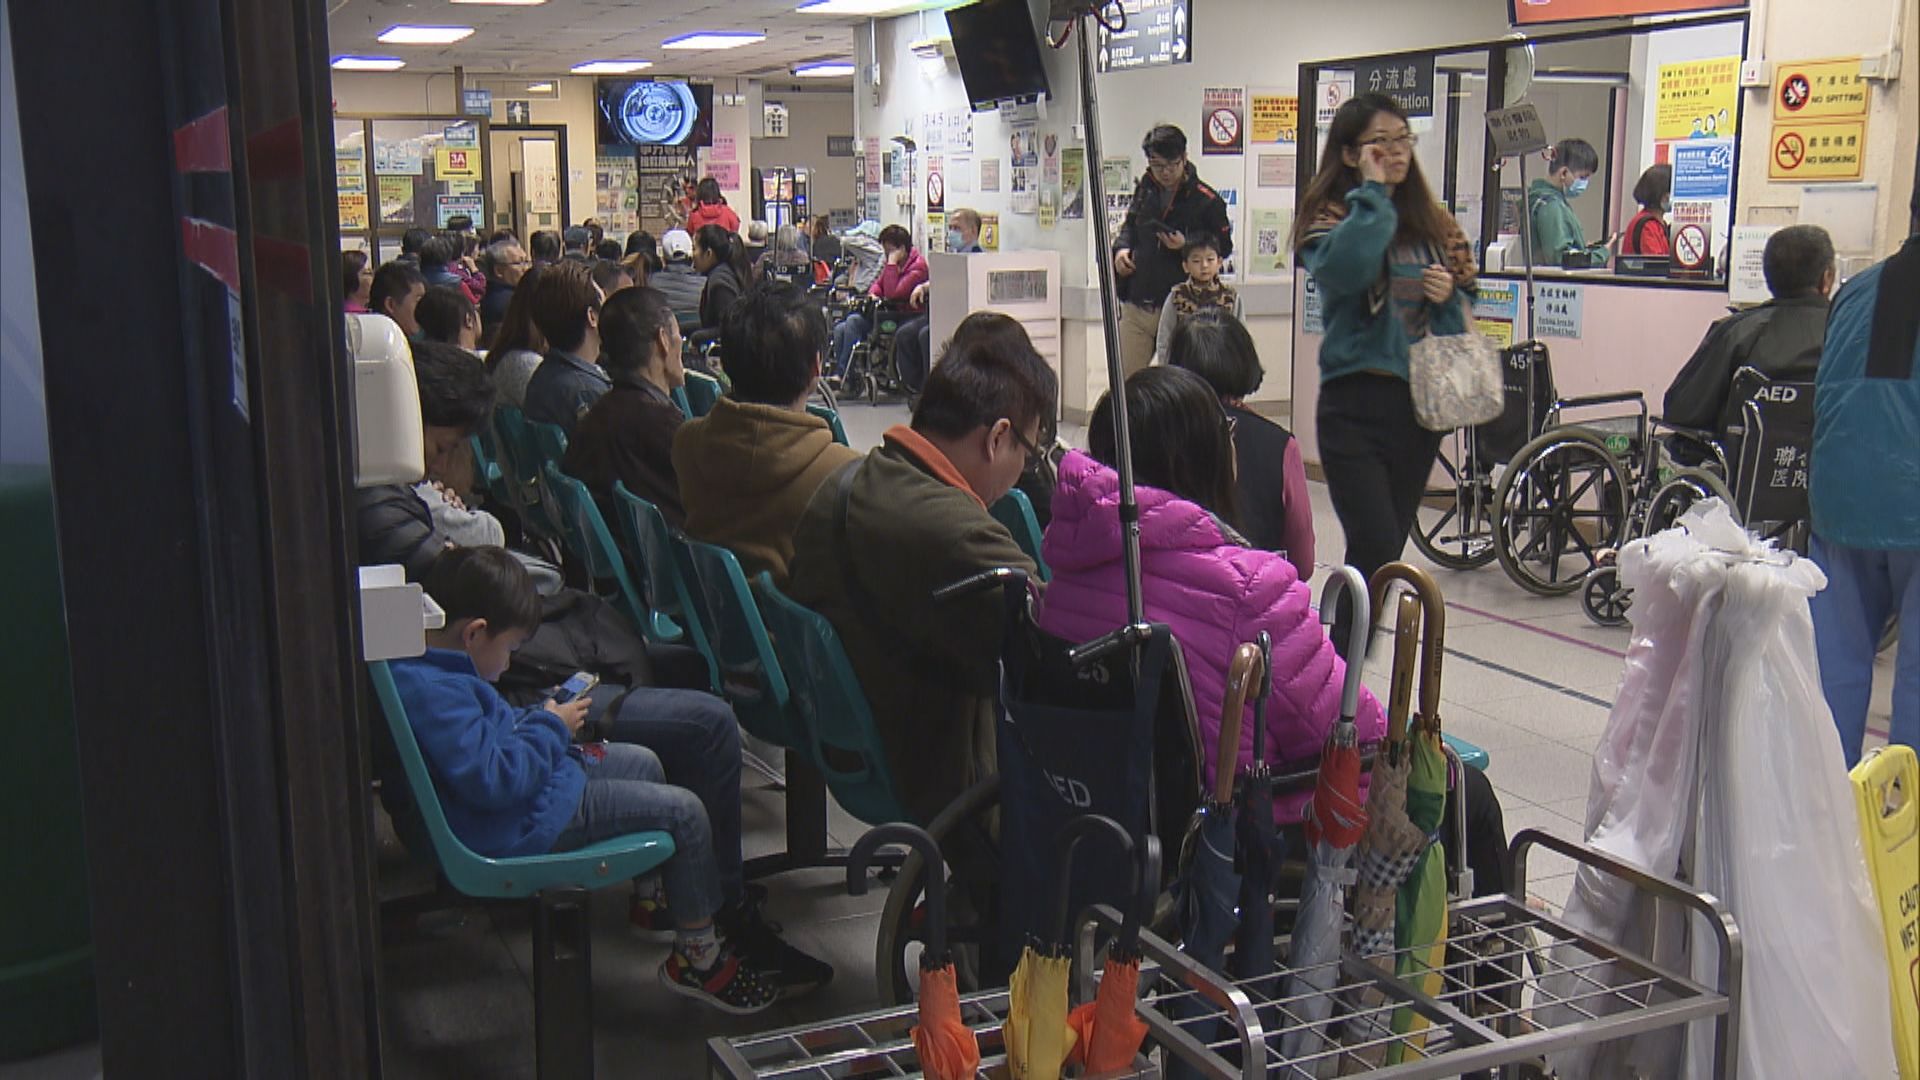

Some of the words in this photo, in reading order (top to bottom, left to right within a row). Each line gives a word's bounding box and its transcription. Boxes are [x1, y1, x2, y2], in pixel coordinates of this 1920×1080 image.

[1369, 65, 1417, 92] 分流處
[1811, 95, 1823, 104] NO
[1826, 92, 1863, 103] SPITTING
[1805, 155, 1817, 164] NO
[1818, 154, 1857, 164] SMOKING
[1753, 386, 1798, 403] AED
